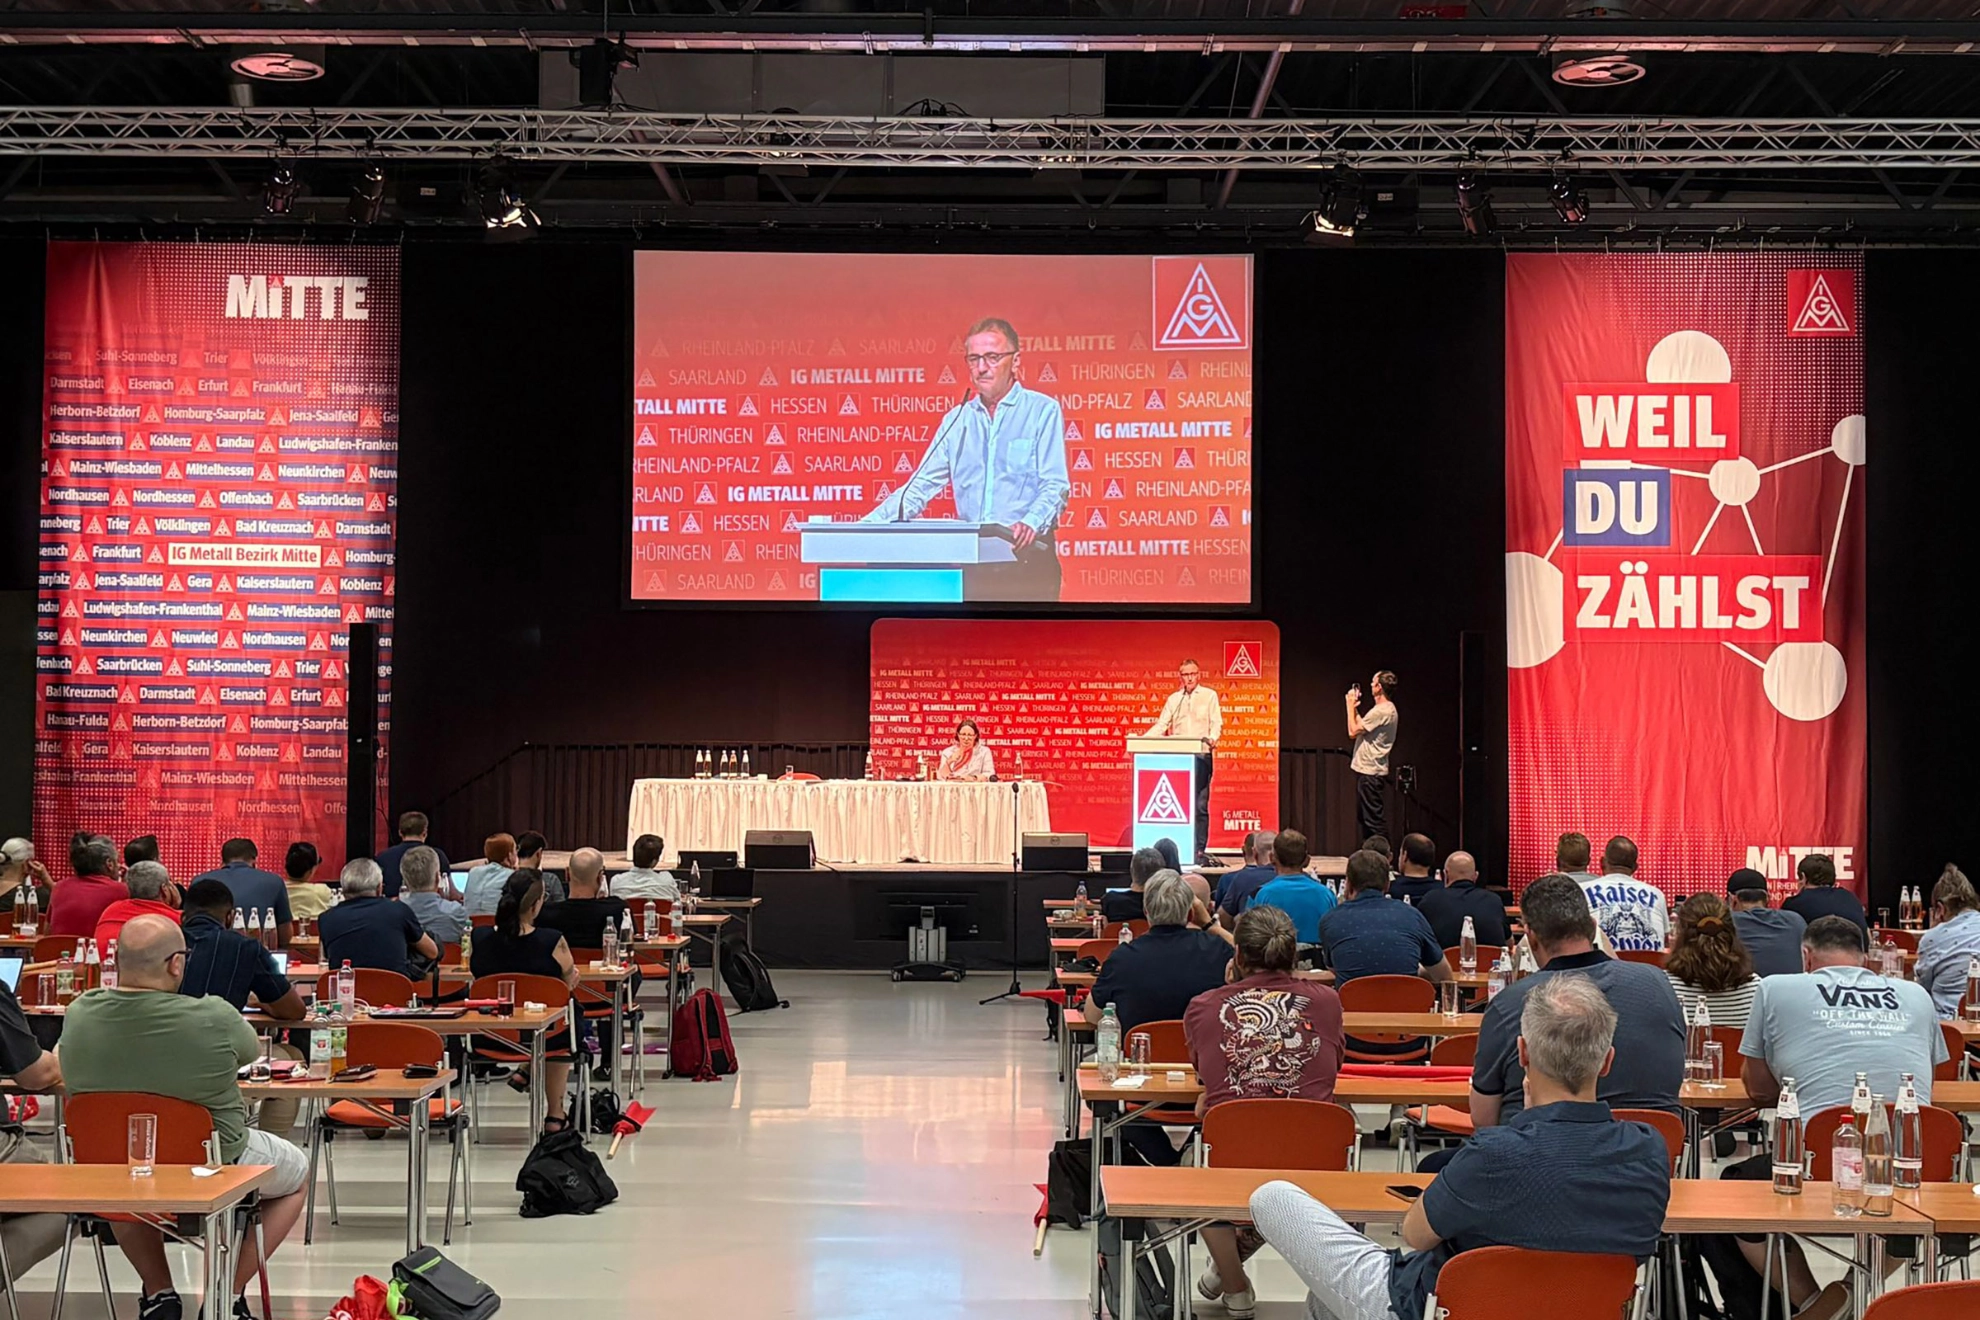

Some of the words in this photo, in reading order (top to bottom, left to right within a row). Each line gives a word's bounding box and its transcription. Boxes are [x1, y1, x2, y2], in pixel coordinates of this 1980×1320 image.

[1066, 335, 1116, 351] MITTE
[95, 350, 177, 365] Suhl-Sonneberg
[203, 352, 229, 364] Trier
[669, 369, 747, 385] SAARLAND
[791, 369, 807, 384] IG
[811, 368, 872, 384] METALL
[876, 368, 925, 383] MITTE
[1071, 362, 1155, 380] THÜRINGEN
[50, 377, 104, 388] Darmstadt
[128, 378, 174, 390] Eisenach
[198, 380, 229, 392] Erfurt
[252, 381, 302, 393] Frankfurt
[676, 399, 727, 414] MITTE
[770, 398, 827, 414] HESSEN
[872, 394, 955, 412] THÜRINGEN
[50, 405, 141, 418] Herborn-Betzdorf
[164, 406, 265, 422] Homburg-Saarpfalz
[289, 410, 358, 423] Jena-Saalfeld
[1576, 395, 1727, 448] WEIL
[50, 433, 123, 445] Kaiserslautern
[150, 435, 192, 446] Koblenz
[216, 436, 255, 448] Landau
[669, 425, 753, 444] THÜRINGEN
[797, 426, 929, 443] RHEINLAND-PFALZ
[1095, 423, 1112, 439] IG
[1115, 422, 1177, 438] METALL
[1181, 421, 1232, 437] MITTE
[69, 461, 162, 474] Mainz-Wiesbaden
[186, 463, 254, 476] Mittelhessen
[278, 465, 345, 478] Neunkirchen
[805, 455, 882, 472] SAARLAND
[1105, 452, 1162, 468] HESSEN
[49, 489, 109, 501] Nordhausen
[133, 490, 195, 503] Nordhessen
[219, 492, 273, 504] Offenbach
[297, 493, 364, 506] Saarbrücken
[728, 486, 744, 502] IG
[748, 486, 810, 501] METALL
[813, 486, 863, 501] MITTE
[1575, 481, 1658, 535] DU
[106, 518, 130, 530] Trier
[155, 518, 211, 533] Völklingen
[236, 520, 256, 532] Bad
[259, 521, 314, 533] Kreuznach
[335, 523, 391, 535] Darmstadt
[714, 515, 769, 531] HESSEN
[1118, 510, 1197, 526] SAARLAND
[92, 546, 142, 558] Frankfurt
[172, 546, 186, 559] IG
[190, 547, 232, 561] Metall
[236, 548, 279, 561] Bezirk
[282, 549, 317, 562] Mitte
[1074, 541, 1135, 556] METALL
[1139, 540, 1190, 555] MITTE
[94, 574, 163, 587] Jena-Saalfeld
[187, 575, 212, 587] Gera
[237, 577, 313, 589] Kaiserslautern
[340, 578, 382, 590] Koblenz
[677, 574, 755, 590] SAARLAND
[1079, 567, 1164, 585] THÜRINGEN
[1576, 560, 1809, 629] ZÄHLST
[84, 602, 223, 617] Ludwigshafen-Frankenthal
[247, 605, 341, 617] Mainz-Wiesbaden
[81, 629, 147, 642] Neunkirchen
[171, 631, 218, 643] Neuwied
[242, 632, 306, 645] Nordhausen
[97, 657, 162, 671] Saarbrücken
[186, 659, 271, 676] Suhl-Sonneberg
[295, 661, 321, 673] Trier
[63, 685, 118, 698] Kreuznach
[140, 687, 196, 699] Darmstadt
[220, 688, 266, 701] Eisenach
[291, 690, 321, 702] Erfurt
[132, 715, 227, 728] Herborn-Betzdorf
[84, 743, 108, 754] Gera
[132, 743, 210, 756] Kaiserslautern
[236, 745, 279, 757] Koblenz
[303, 746, 342, 758] Landau
[161, 772, 254, 784] Mainz-Wiesbaden
[279, 773, 347, 786] Mittelhessen
[237, 802, 300, 814] Nordhessen
[1222, 810, 1231, 819] IG
[1232, 810, 1261, 819] METALL
[1224, 819, 1261, 831] MITTE
[1585, 882, 1658, 909] Kaiser
[1816, 983, 1899, 1010] VANS
